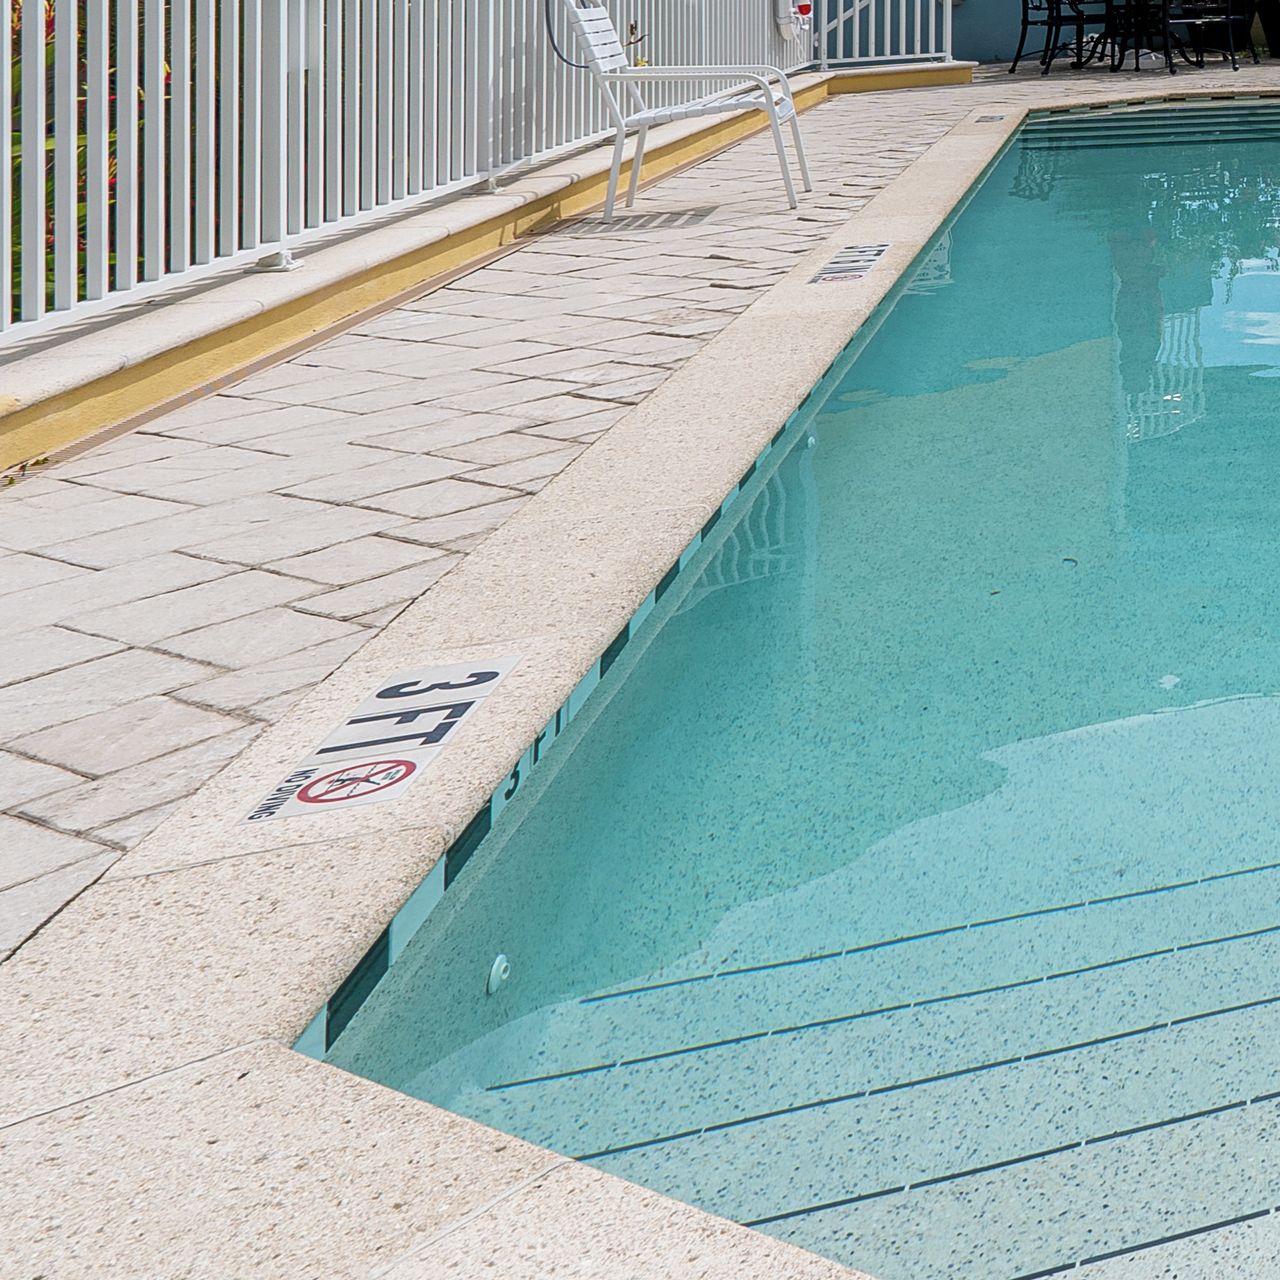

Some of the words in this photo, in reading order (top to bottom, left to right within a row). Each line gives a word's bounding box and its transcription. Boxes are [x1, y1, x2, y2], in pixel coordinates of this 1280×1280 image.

[375, 671, 500, 699] 3
[316, 700, 477, 756] FT
[285, 767, 320, 783] NO
[247, 783, 304, 821] DIVING
